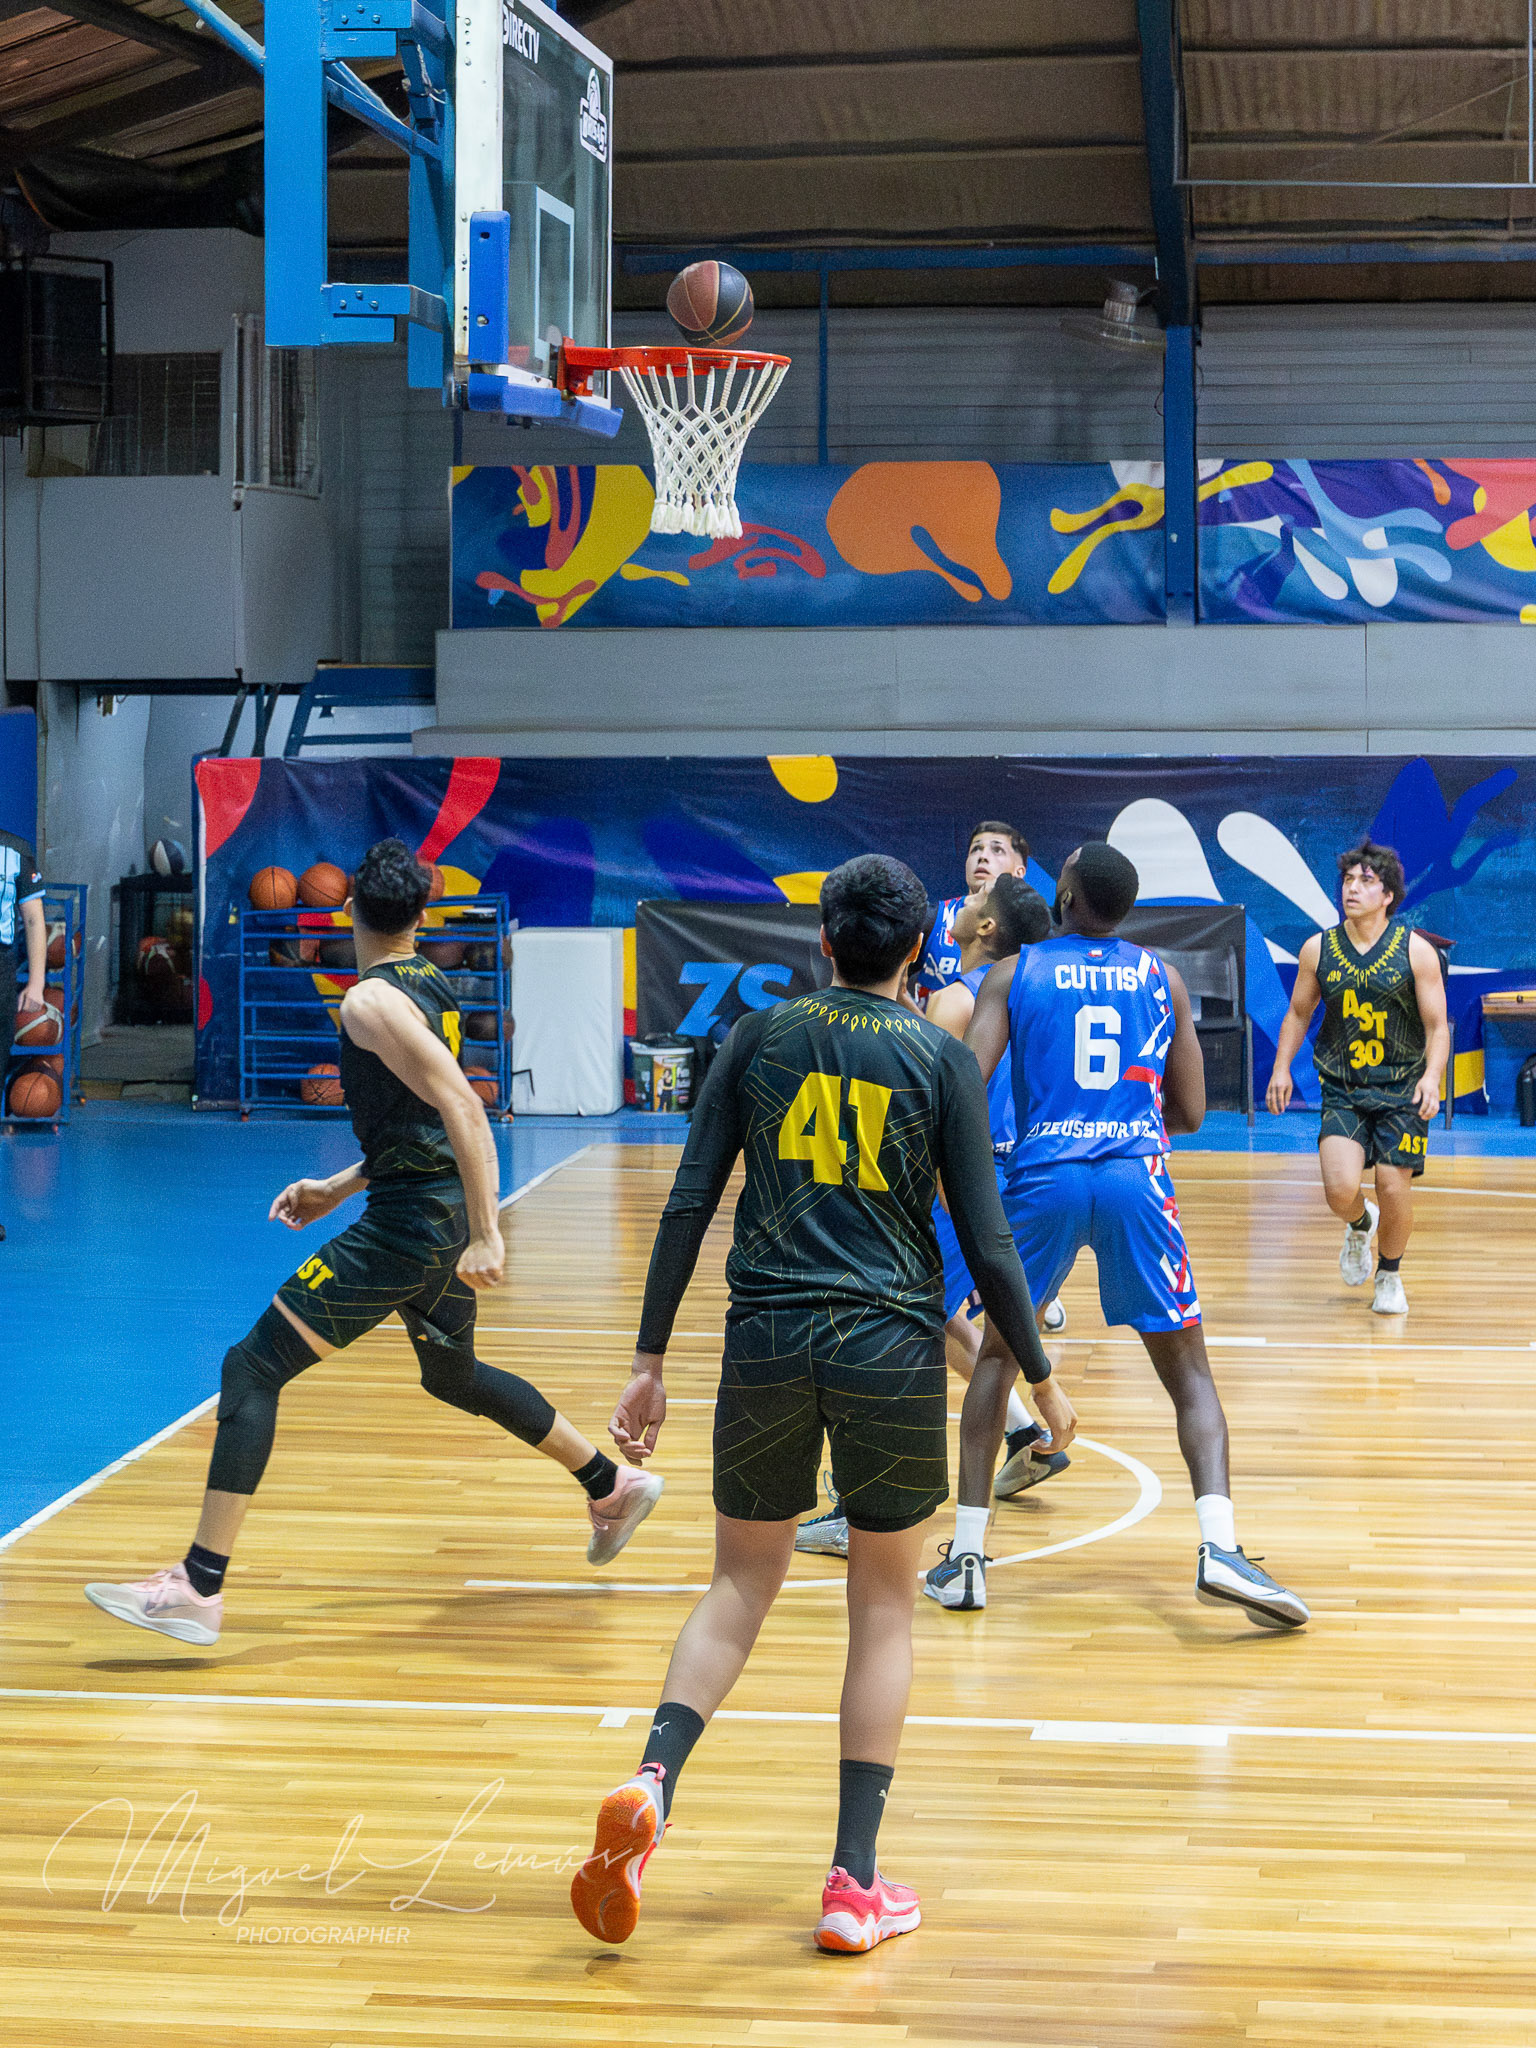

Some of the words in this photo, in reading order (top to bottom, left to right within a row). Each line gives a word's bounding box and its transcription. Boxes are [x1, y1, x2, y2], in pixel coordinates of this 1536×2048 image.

[1054, 964, 1138, 991] CUTTIS
[1342, 988, 1388, 1040] AST
[1074, 1004, 1121, 1091] 6
[1349, 1039, 1385, 1070] 30
[778, 1072, 893, 1191] 41
[296, 1253, 335, 1290] ST
